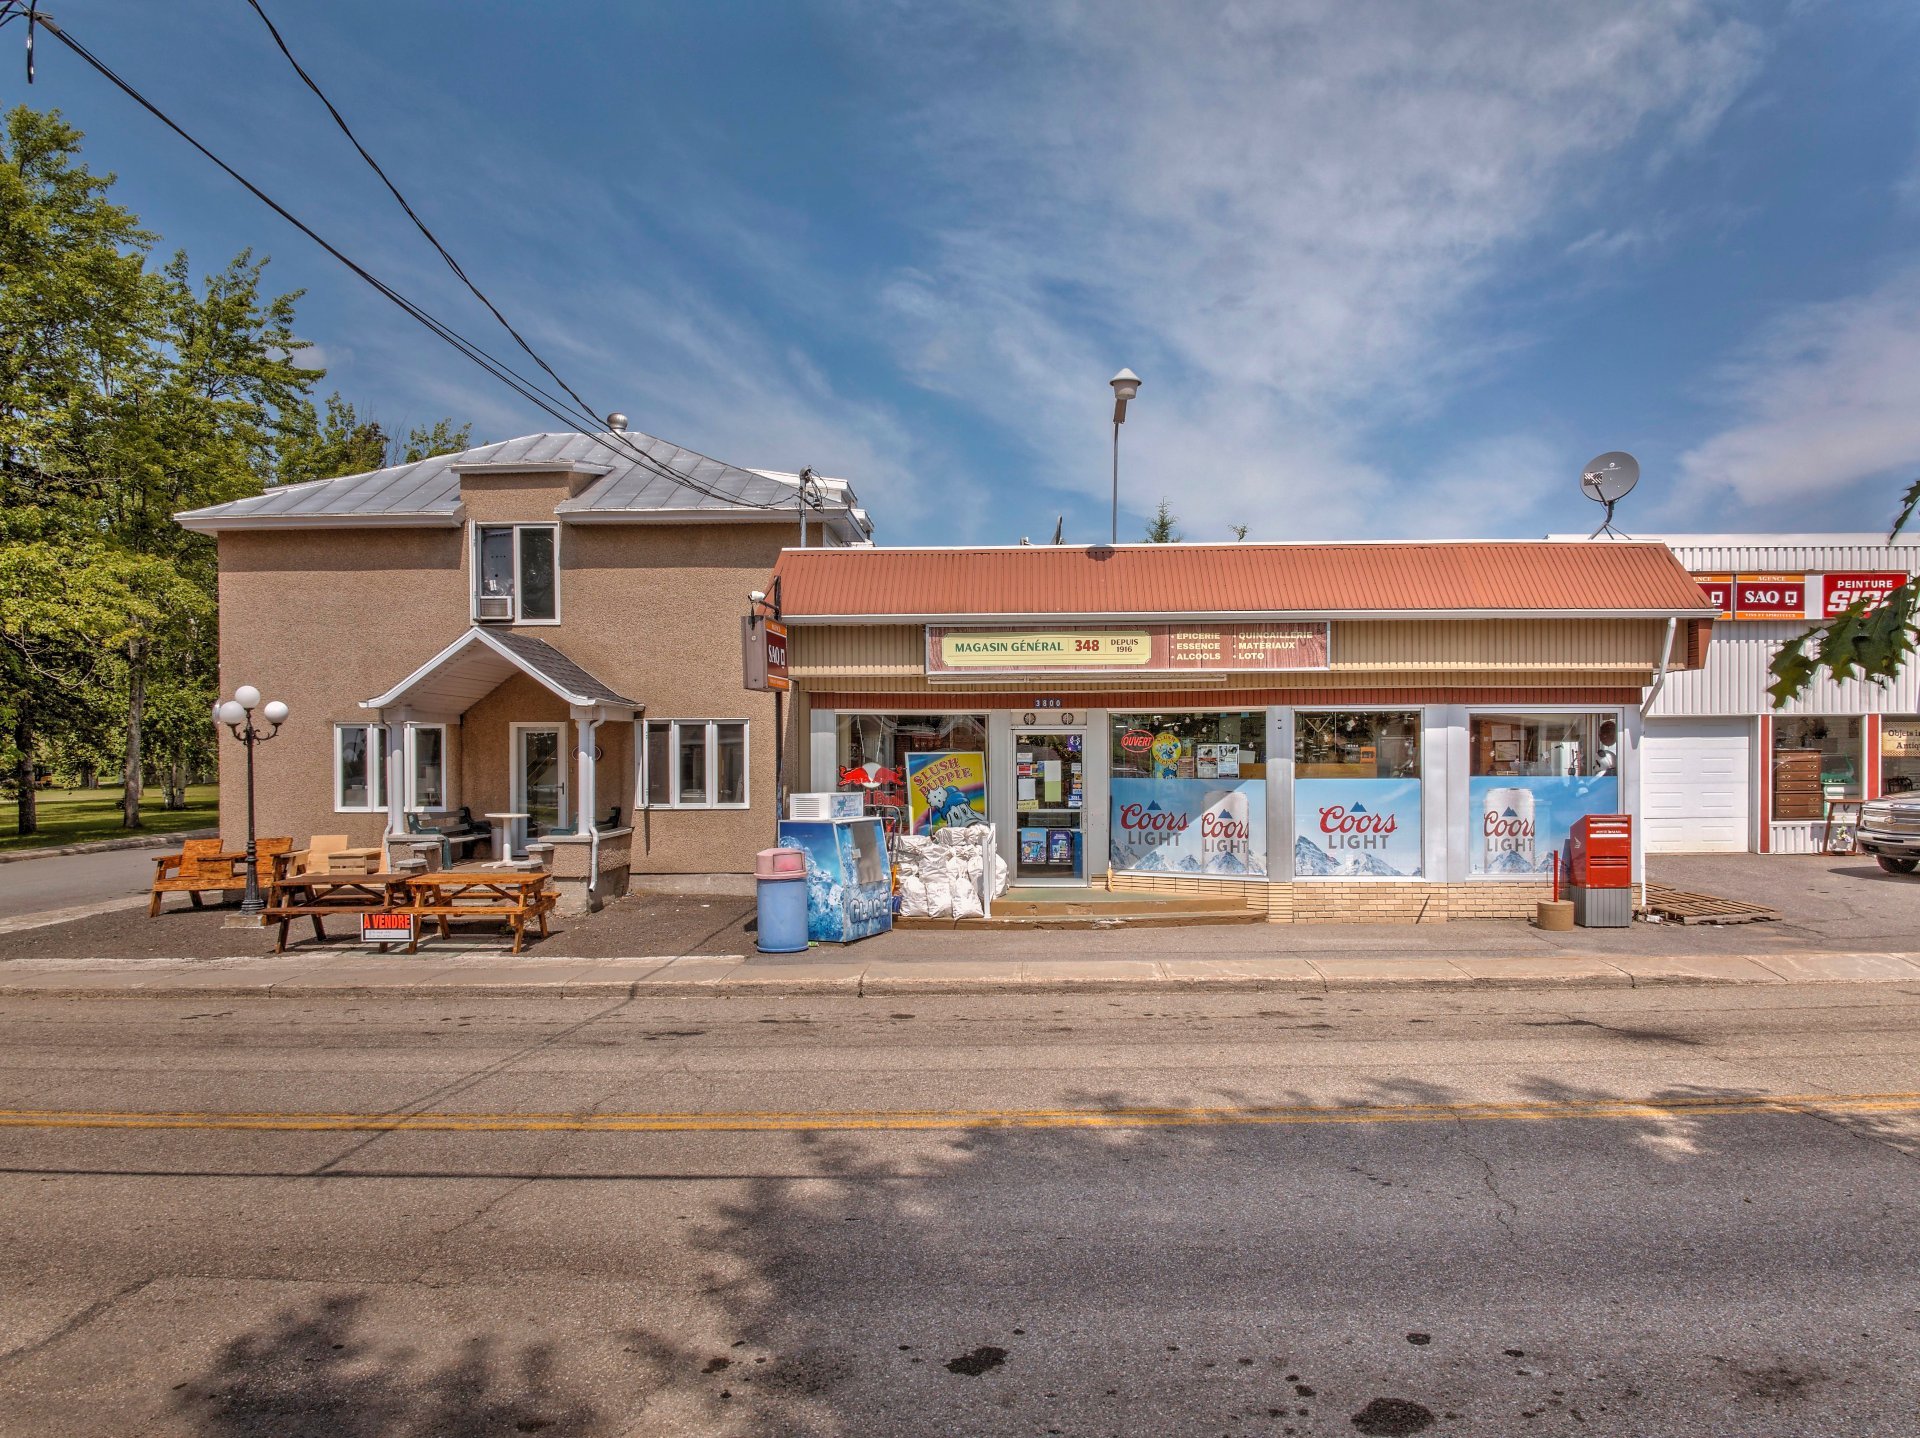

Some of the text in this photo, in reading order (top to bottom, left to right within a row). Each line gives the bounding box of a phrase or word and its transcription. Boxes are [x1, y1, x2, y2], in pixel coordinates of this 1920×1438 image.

[1837, 580, 1893, 588] PEINTURE
[1745, 590, 1780, 604] SAQ
[1110, 638, 1139, 646] DEPUIS
[1176, 631, 1220, 640] ÉPICERIE
[1238, 631, 1313, 640] QUINCAILLERIE
[955, 640, 1064, 653] MAGASIN GÉNÉRAL
[1075, 639, 1100, 652] 348
[1116, 645, 1133, 653] 1916
[1238, 641, 1295, 650] MATÉRIAUX
[768, 644, 780, 666] SAQ
[1238, 652, 1265, 660] LOTO
[1123, 736, 1153, 747] OUVERT
[913, 757, 961, 786] SLUSH
[919, 767, 972, 800] PUPPIE
[1120, 803, 1190, 831] Coors
[1319, 805, 1398, 833] Coors
[1128, 831, 1182, 846] LIGHT
[1328, 835, 1390, 849] LIGHT
[1487, 838, 1533, 852] LIGHT
[1204, 840, 1248, 853] LIGHT
[372, 914, 411, 929] VENDRE
